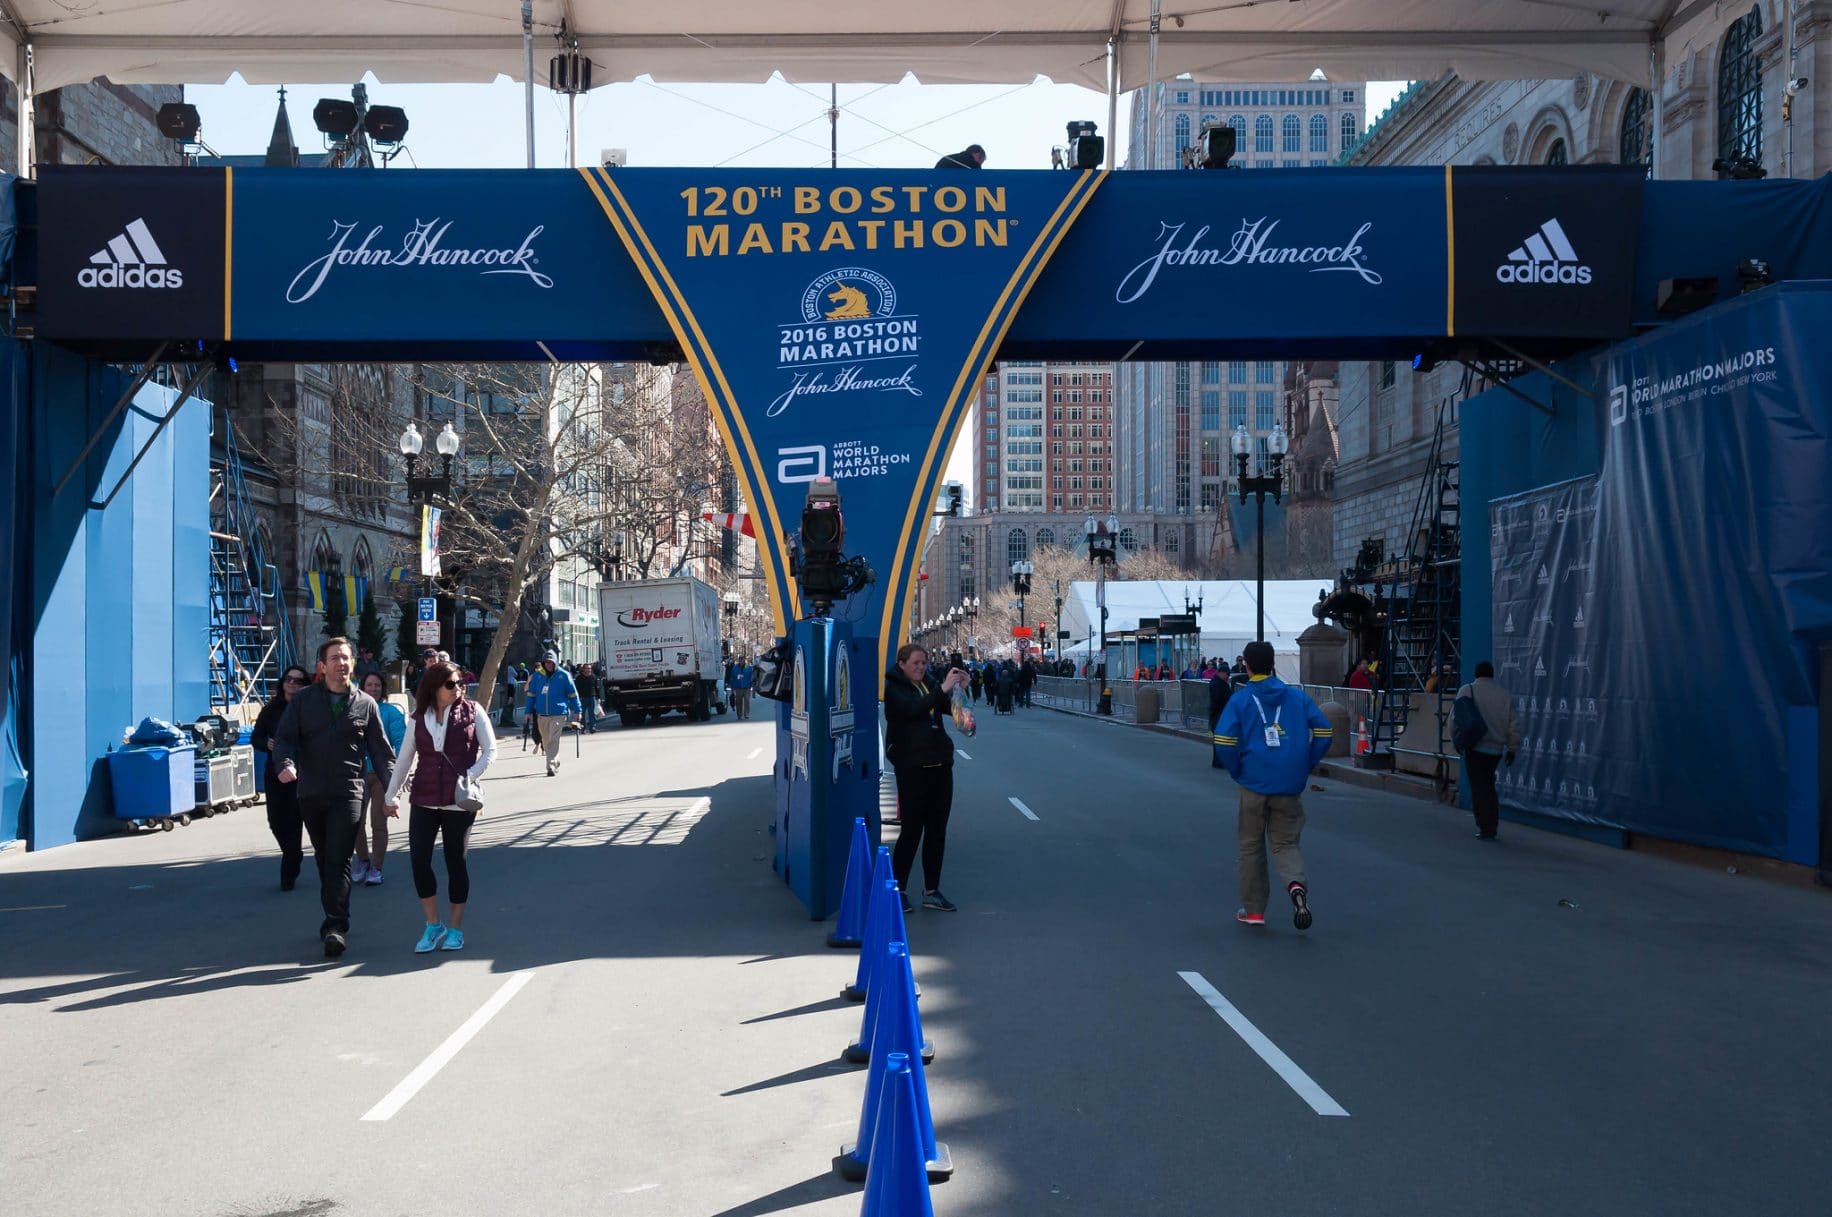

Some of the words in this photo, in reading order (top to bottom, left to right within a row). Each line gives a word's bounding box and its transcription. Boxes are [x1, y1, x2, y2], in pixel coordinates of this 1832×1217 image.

[680, 186, 781, 216] 120TH
[794, 186, 1006, 214] BOSTON
[686, 219, 1008, 257] MARATHON
[286, 219, 396, 303] John
[391, 217, 554, 289] Hancock
[1116, 220, 1221, 303] John
[1218, 216, 1383, 285] Hancock
[1496, 259, 1592, 285] adidas
[77, 262, 183, 289] adidas
[805, 289, 818, 319] BOSTON
[815, 269, 861, 290] ATHLETIC
[860, 270, 894, 313] ASSOCIATION
[780, 328, 828, 344] 2016
[834, 320, 917, 340] BOSTON
[780, 336, 918, 363] MARATHON
[1660, 363, 1725, 396] MARATHON
[1724, 347, 1776, 375] MAJORS
[1751, 370, 1777, 384] YORK
[766, 372, 829, 418] John
[826, 364, 923, 397] Hancock
[833, 440, 862, 449] ABBOTT
[833, 446, 880, 459] WORLD
[833, 453, 911, 469] MARATHON
[833, 465, 888, 480] MAJORS
[632, 607, 681, 623] Ryder
[632, 637, 652, 645] Rental
[660, 635, 684, 643] Leasing
